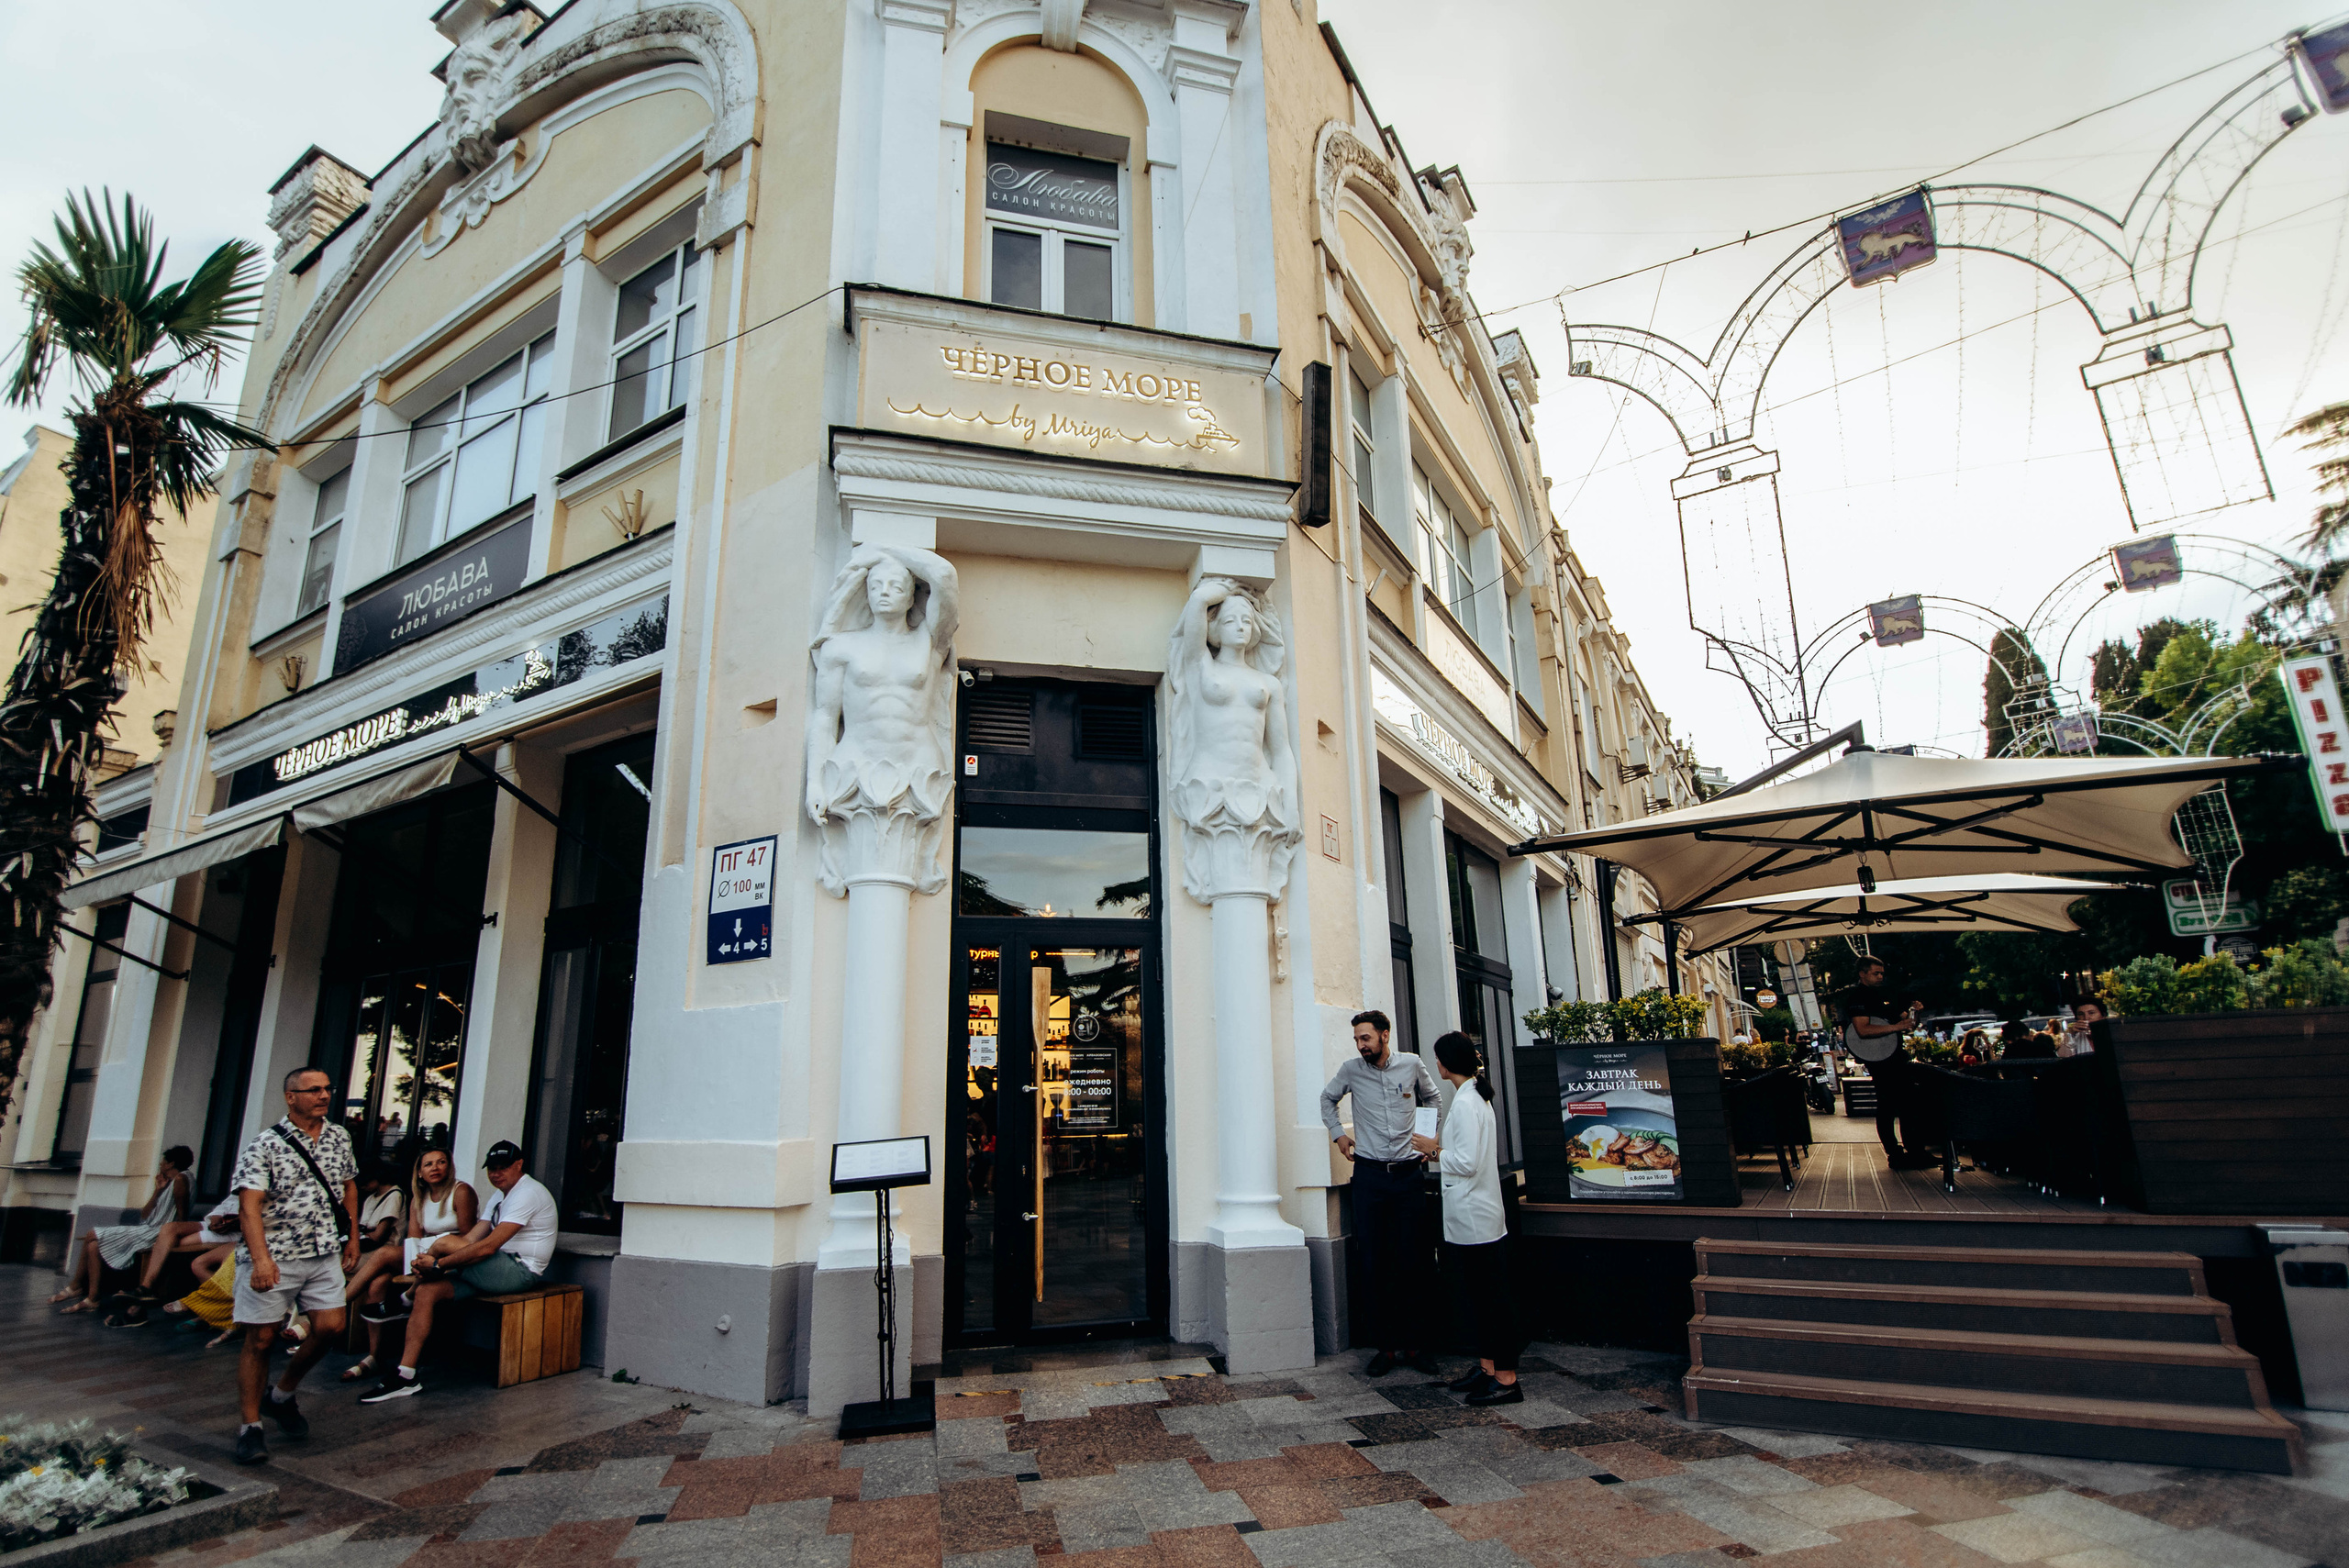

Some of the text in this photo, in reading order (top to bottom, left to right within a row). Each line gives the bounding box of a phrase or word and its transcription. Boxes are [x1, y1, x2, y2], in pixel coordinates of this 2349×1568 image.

[987, 162, 1118, 207] Любава
[992, 192, 1116, 221] САЛОН КРАСОТЫ
[940, 346, 1203, 403] ЧЁРНОЕ МОРЕ
[1010, 403, 1117, 450] by Mriya
[397, 556, 489, 620] ЛЮБАВА
[390, 583, 494, 639] САЛОН КРАСОТЫ
[1444, 639, 1486, 697] ЛЮБАВА
[274, 707, 409, 781] ЧЁРНОЕ МОРЕ
[1415, 712, 1497, 795] ЧЁРНОЕ МОРЕ
[720, 846, 767, 873] ПГ 47
[733, 878, 752, 895] 100
[754, 892, 764, 900] ВК
[733, 938, 768, 954] 4 5
[1063, 1078, 1112, 1086] ежедневно
[1567, 1079, 1662, 1092] КАЖДЫЙ ДЕНЬ
[1586, 1069, 1639, 1080] ЗАВТРАК
[1088, 1087, 1112, 1095] 00:00
